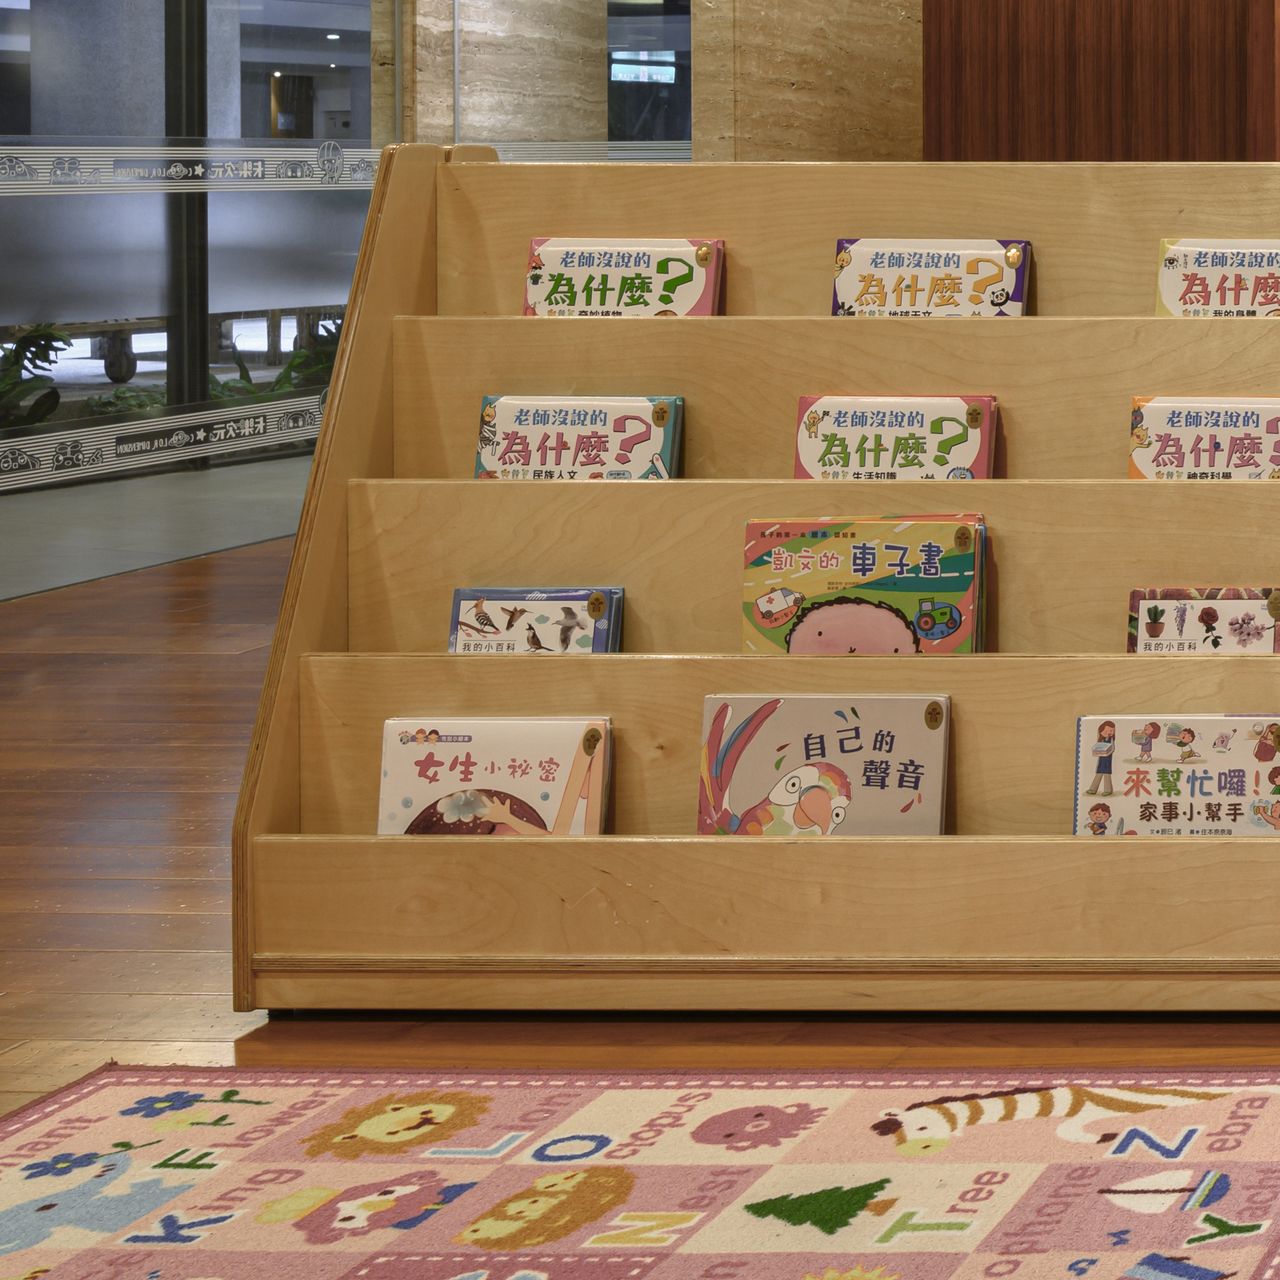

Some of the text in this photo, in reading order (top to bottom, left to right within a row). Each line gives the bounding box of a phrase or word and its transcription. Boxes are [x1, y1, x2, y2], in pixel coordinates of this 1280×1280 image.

[560, 251, 651, 268] 老師沒說的
[870, 251, 960, 269] 老師沒說的
[514, 408, 608, 426] 老師沒說的
[833, 410, 924, 428] 老師沒說的
[1166, 410, 1260, 428] 老師沒說的
[770, 541, 945, 577] 凱文的 車子書
[462, 642, 516, 653] 我的小百科
[1143, 642, 1197, 652] 我的小百科
[803, 726, 896, 760] 自己的
[414, 751, 560, 784] 女生小祕密
[861, 759, 925, 790] 聲音
[1122, 767, 1260, 798] 來幫忙囉!
[1139, 801, 1245, 823] 家事小幫手
